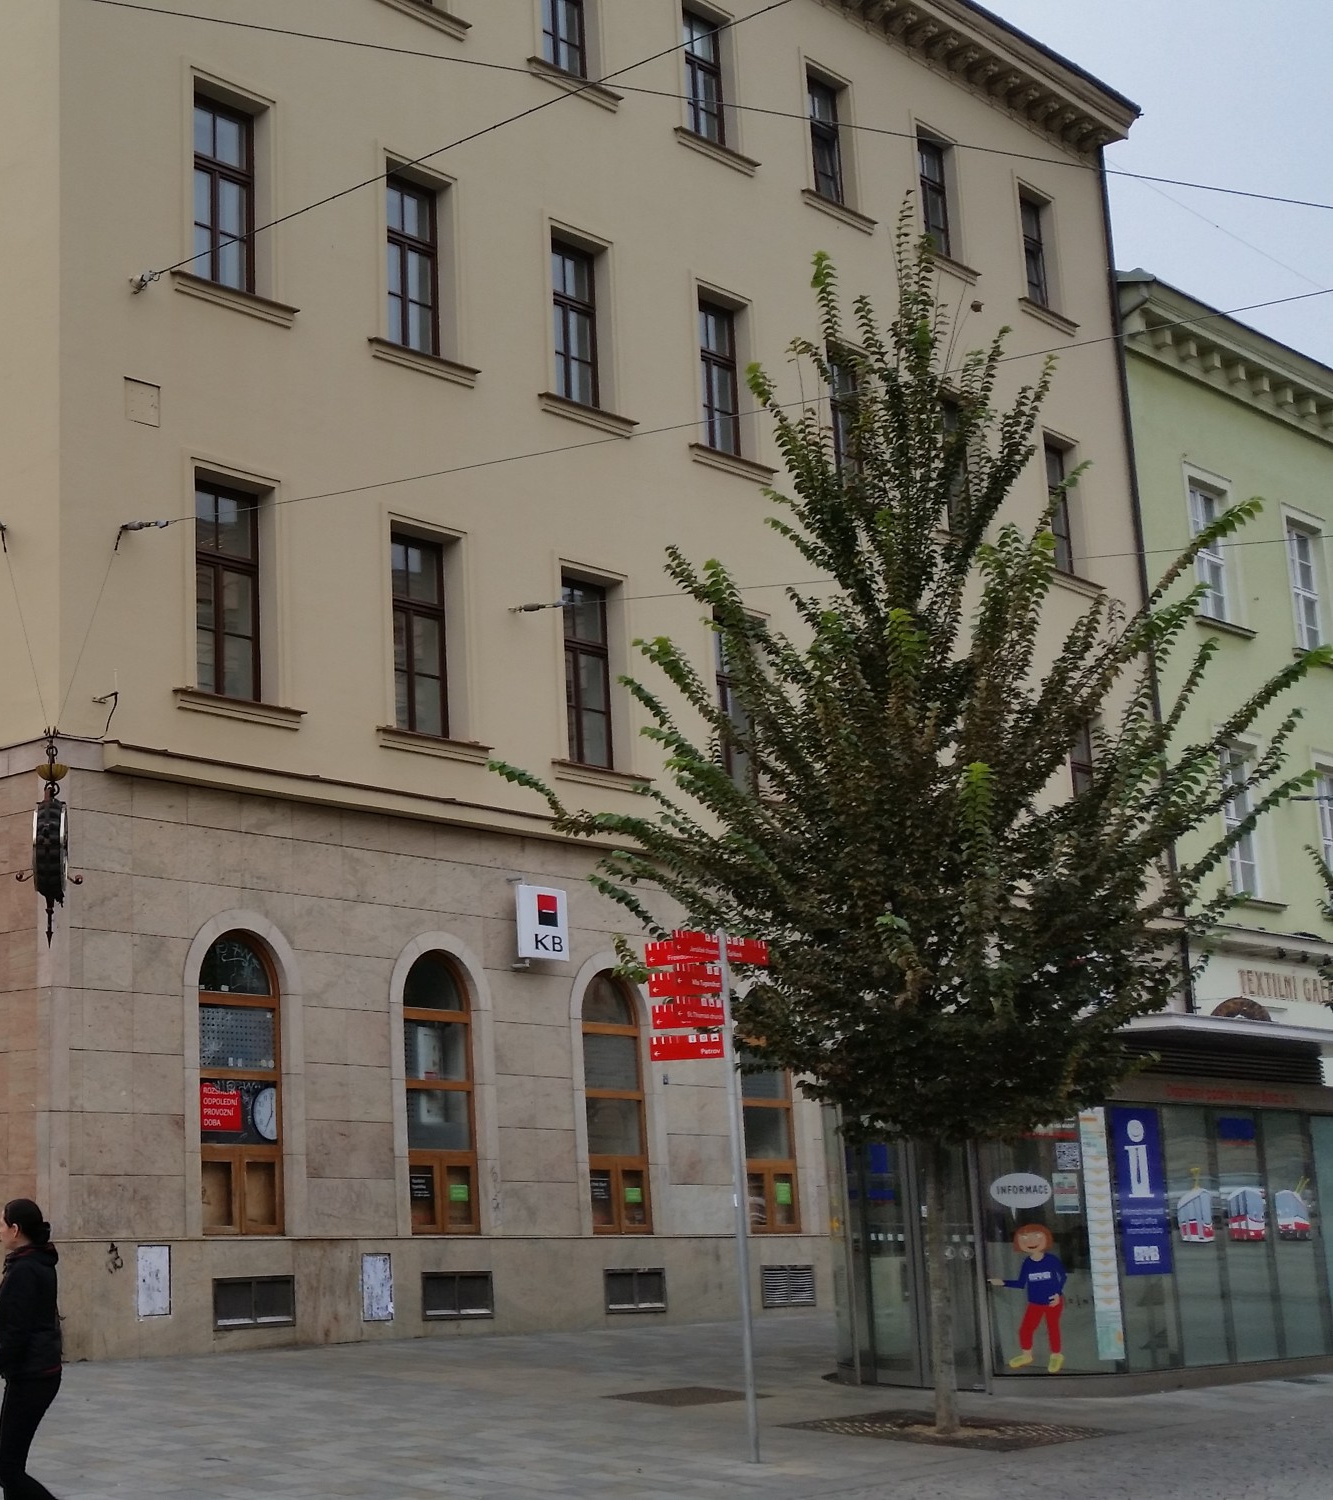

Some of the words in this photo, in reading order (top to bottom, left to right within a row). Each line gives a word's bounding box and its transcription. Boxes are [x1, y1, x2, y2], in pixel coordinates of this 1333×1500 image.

[534, 933, 564, 953] KB
[700, 1047, 721, 1055] Petrov
[203, 1097, 238, 1106] ODPOLEDNÍ
[203, 1108, 234, 1116] PROVOZNÍ
[203, 1118, 222, 1127] DOBA
[995, 1184, 1049, 1196] INFORMACE
